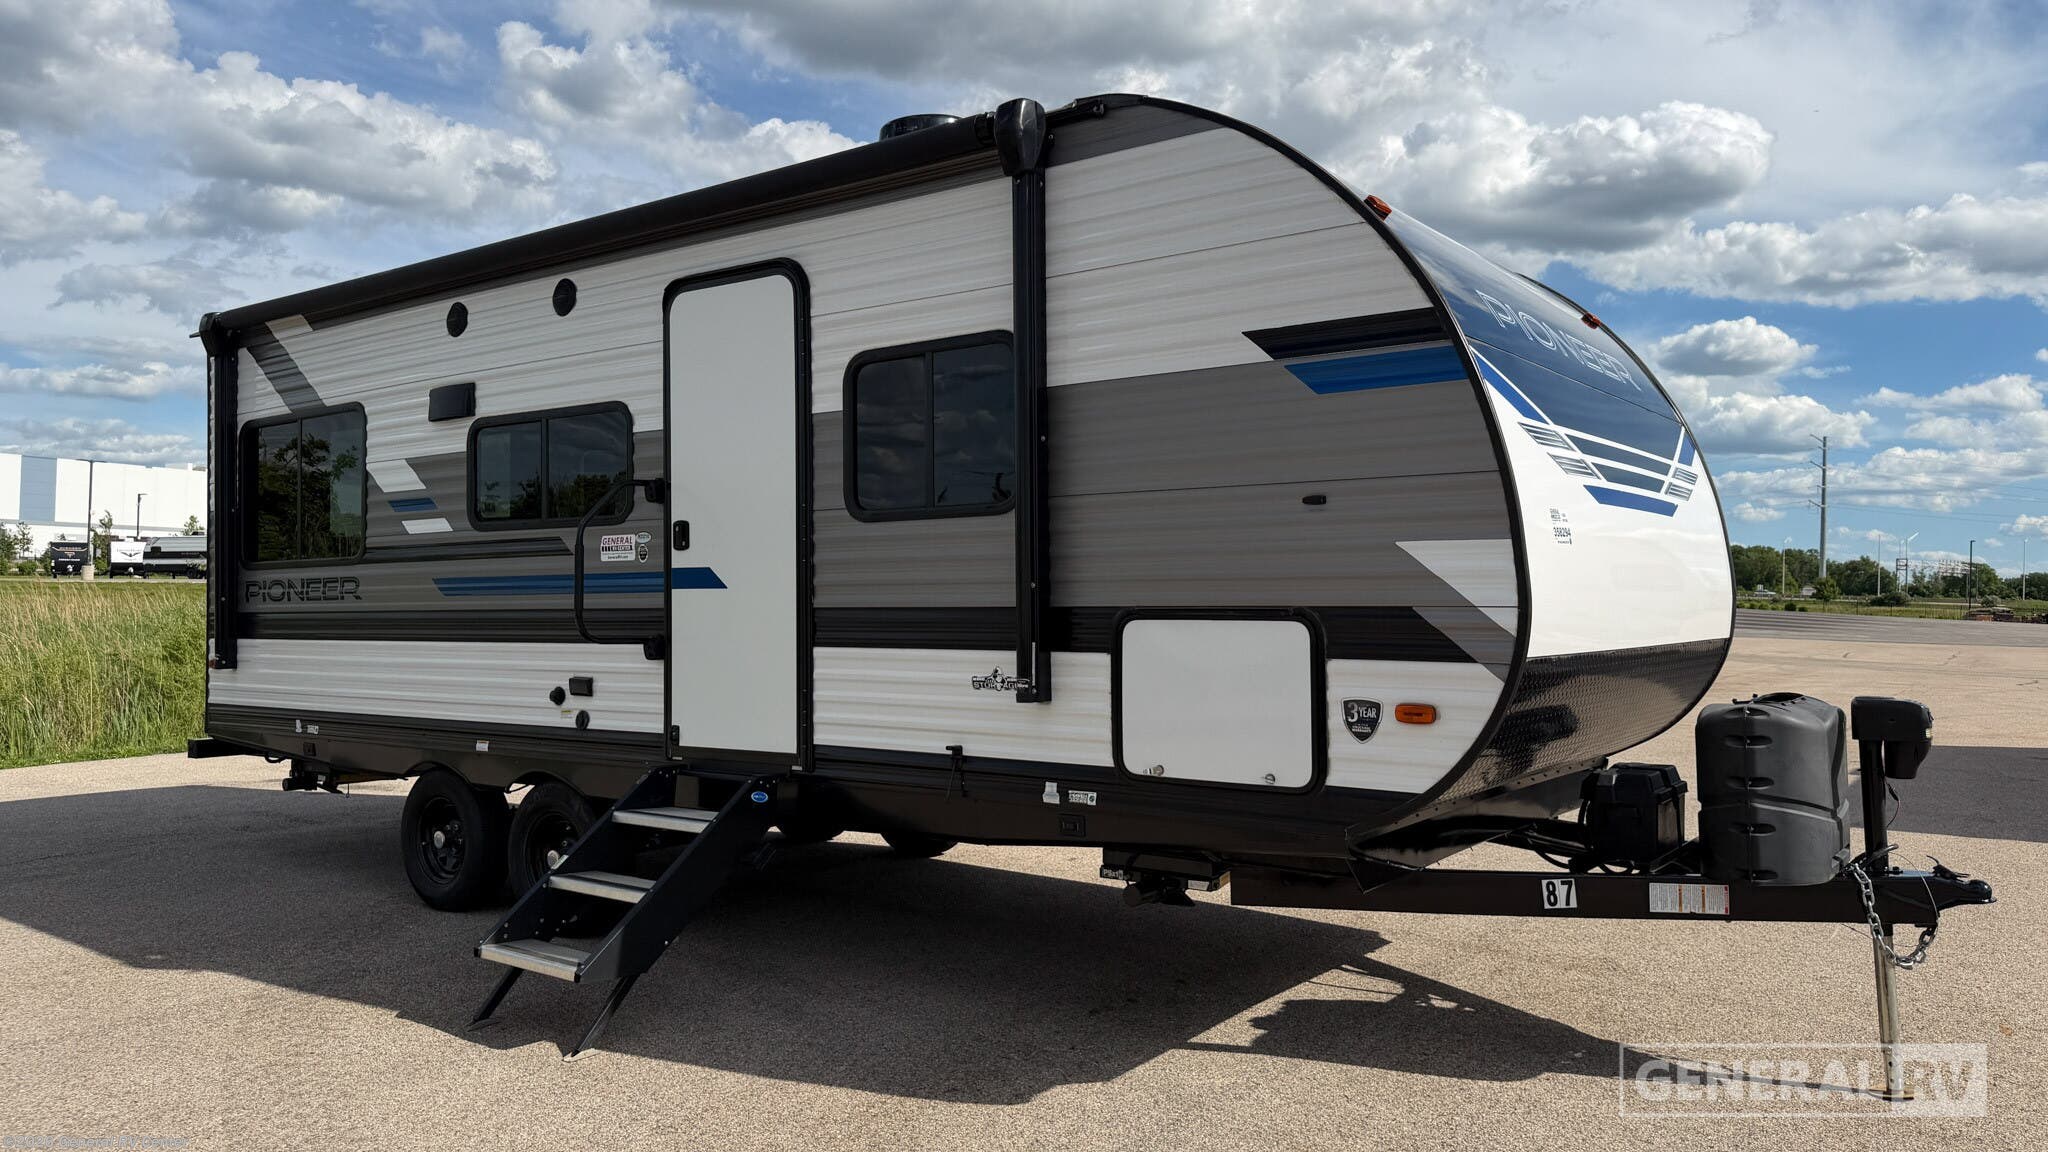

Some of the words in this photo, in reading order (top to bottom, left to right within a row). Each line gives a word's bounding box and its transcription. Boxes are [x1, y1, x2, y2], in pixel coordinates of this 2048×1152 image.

[1475, 289, 1642, 392] PIONEER
[602, 536, 633, 545] GENERAL
[245, 576, 362, 602] PIONEER
[1347, 702, 1359, 722] 3
[1359, 706, 1377, 719] YEAR
[1545, 880, 1573, 907] 87
